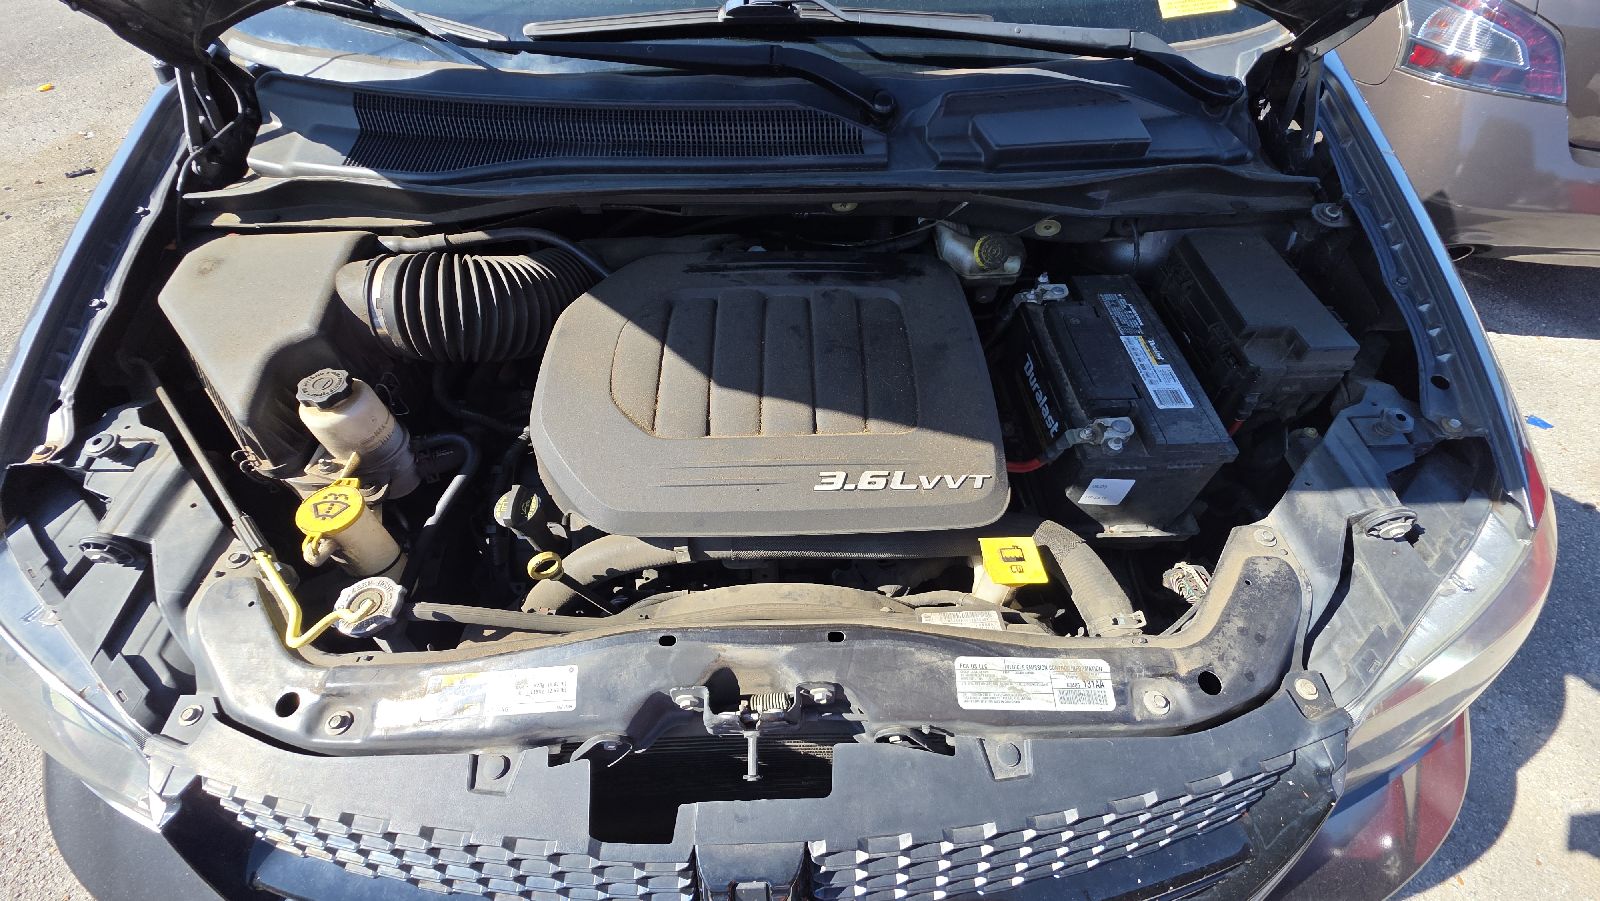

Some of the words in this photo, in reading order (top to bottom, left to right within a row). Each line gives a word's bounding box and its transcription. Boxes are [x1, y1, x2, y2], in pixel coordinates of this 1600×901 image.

[1023, 352, 1060, 439] Duralast
[813, 470, 919, 491] 3.6L
[919, 474, 993, 491] VVT
